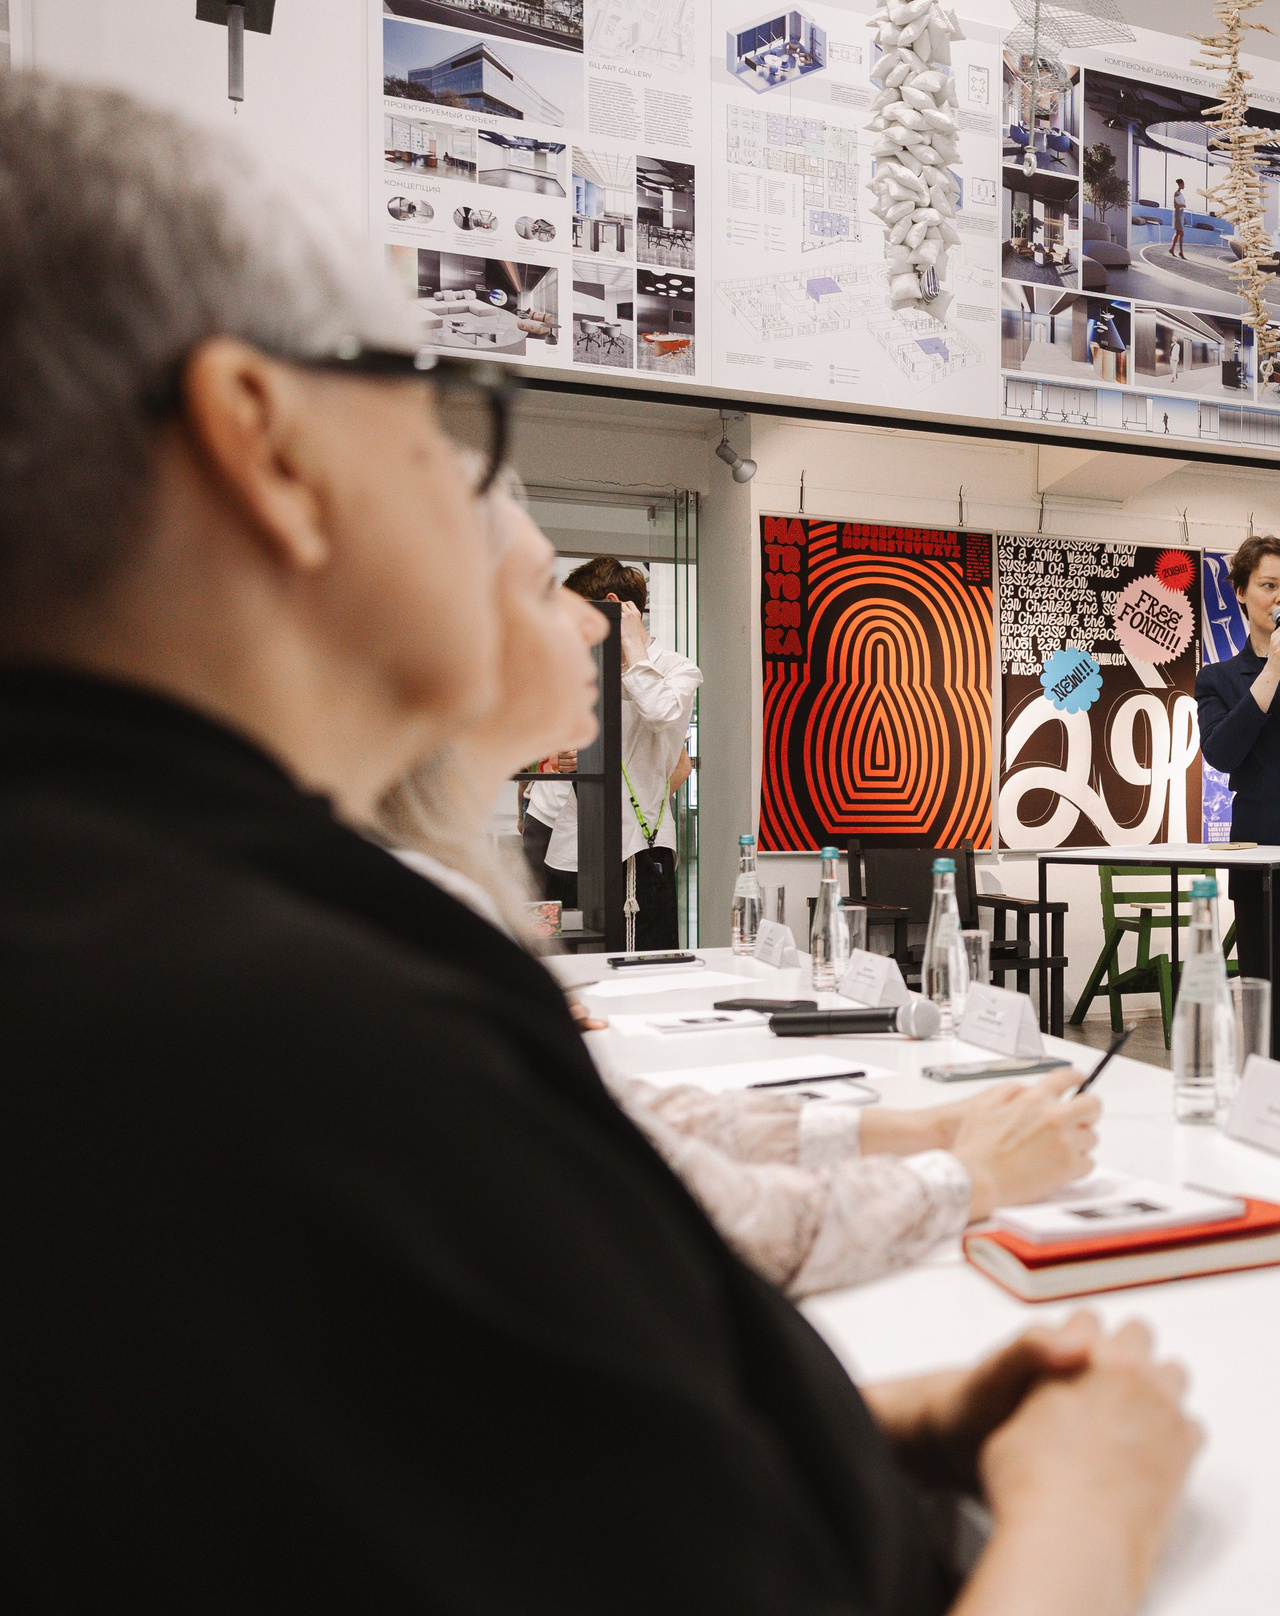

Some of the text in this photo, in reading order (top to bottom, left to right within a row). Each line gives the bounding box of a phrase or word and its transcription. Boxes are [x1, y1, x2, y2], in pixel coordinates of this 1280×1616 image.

[588, 61, 653, 79] БЦ ART GALLERY
[1104, 57, 1154, 74] КОМПЛЕКСНЫЙ
[1155, 68, 1208, 87] ДИЗАЙН-ПРОЕКТ
[1252, 92, 1276, 104] ФИСОВ
[383, 100, 499, 126] ПРОЕКТИРУЕМЫЙ ОБЪЕКТ
[384, 178, 441, 194] КОНЦЕПЦИЯ
[764, 516, 807, 546] MA
[764, 544, 801, 573] TR
[1161, 563, 1189, 579] 2019!!!
[765, 571, 801, 600] YO
[765, 599, 801, 629] SH
[1135, 590, 1184, 632] FREE
[764, 627, 803, 656] KA
[1117, 602, 1182, 654] FONT!!!
[1050, 659, 1094, 702] NEW!!!
